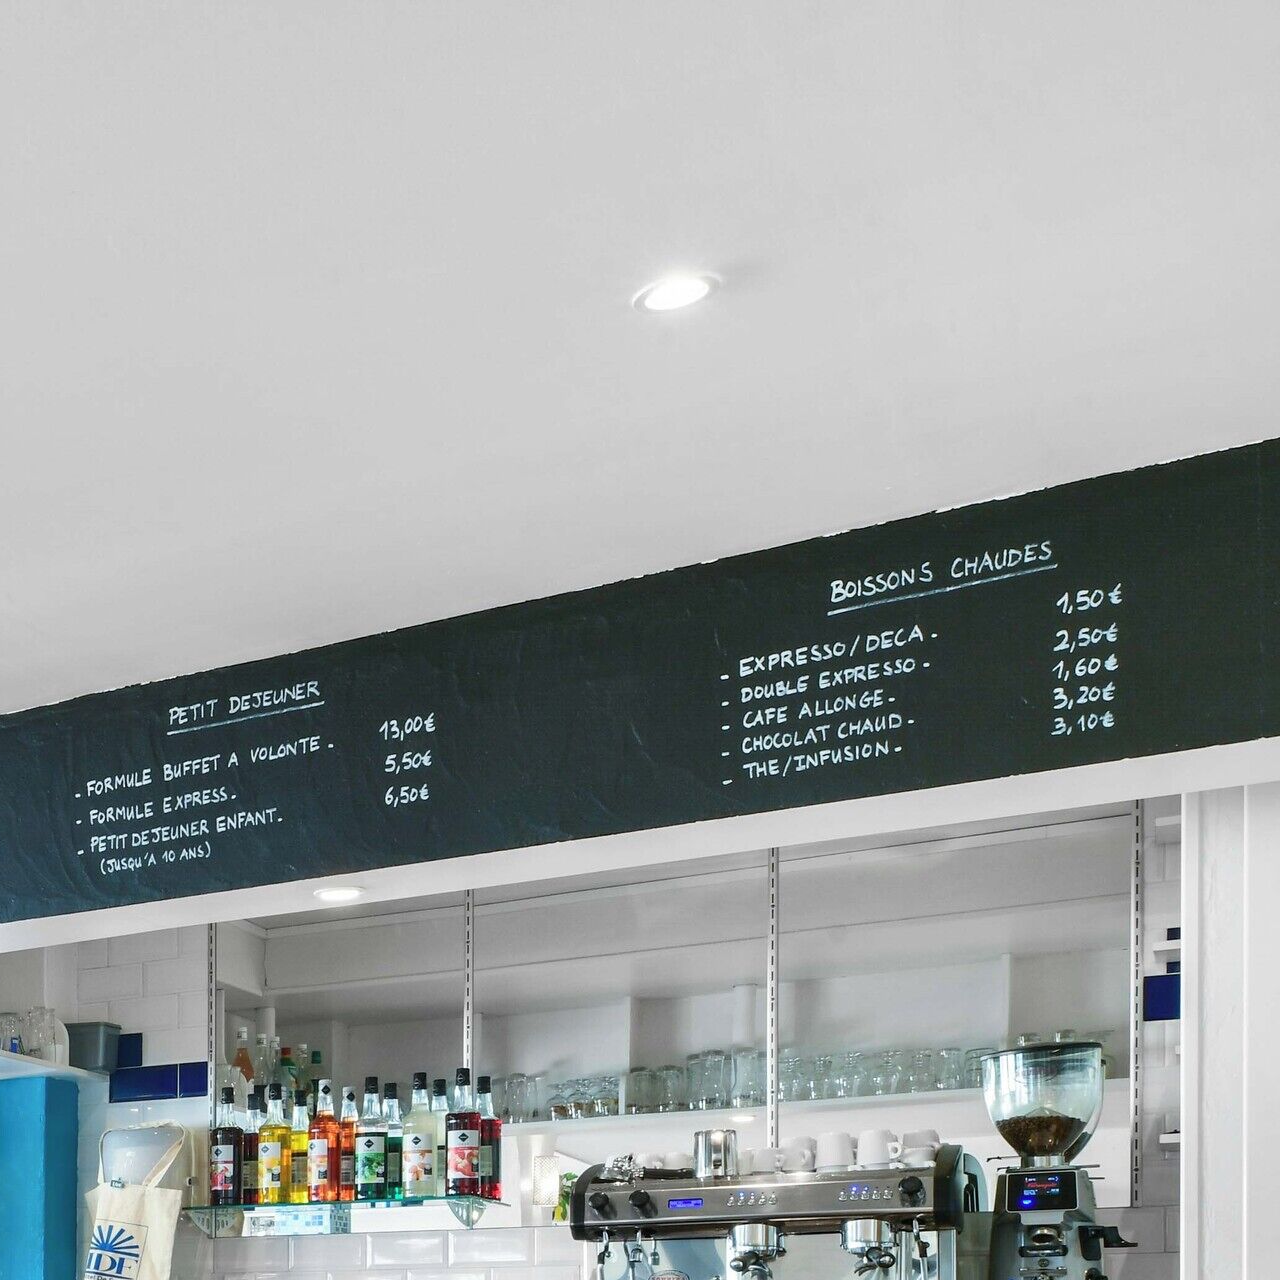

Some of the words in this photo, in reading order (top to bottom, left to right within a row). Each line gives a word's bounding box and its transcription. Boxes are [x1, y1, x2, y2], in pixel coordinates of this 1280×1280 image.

[830, 561, 934, 604] BOISSONS
[950, 540, 1054, 579] CHAUDES
[740, 674, 810, 703] DOUBLE
[818, 658, 916, 689] EXPRESSO
[168, 698, 219, 727] PETIT
[228, 680, 321, 714] DEJEUNER
[742, 705, 788, 729] CAFE
[741, 724, 831, 754] CHOCOLAT
[86, 768, 153, 797] FORMULE
[162, 753, 221, 782] BUFFET
[227, 752, 239, 768] A
[250, 735, 321, 763] VOLONTE
[89, 801, 154, 826] FORMULE
[90, 833, 128, 853] PETIT
[131, 819, 211, 847] DEJEUNER
[179, 844, 211, 861] ANS)
